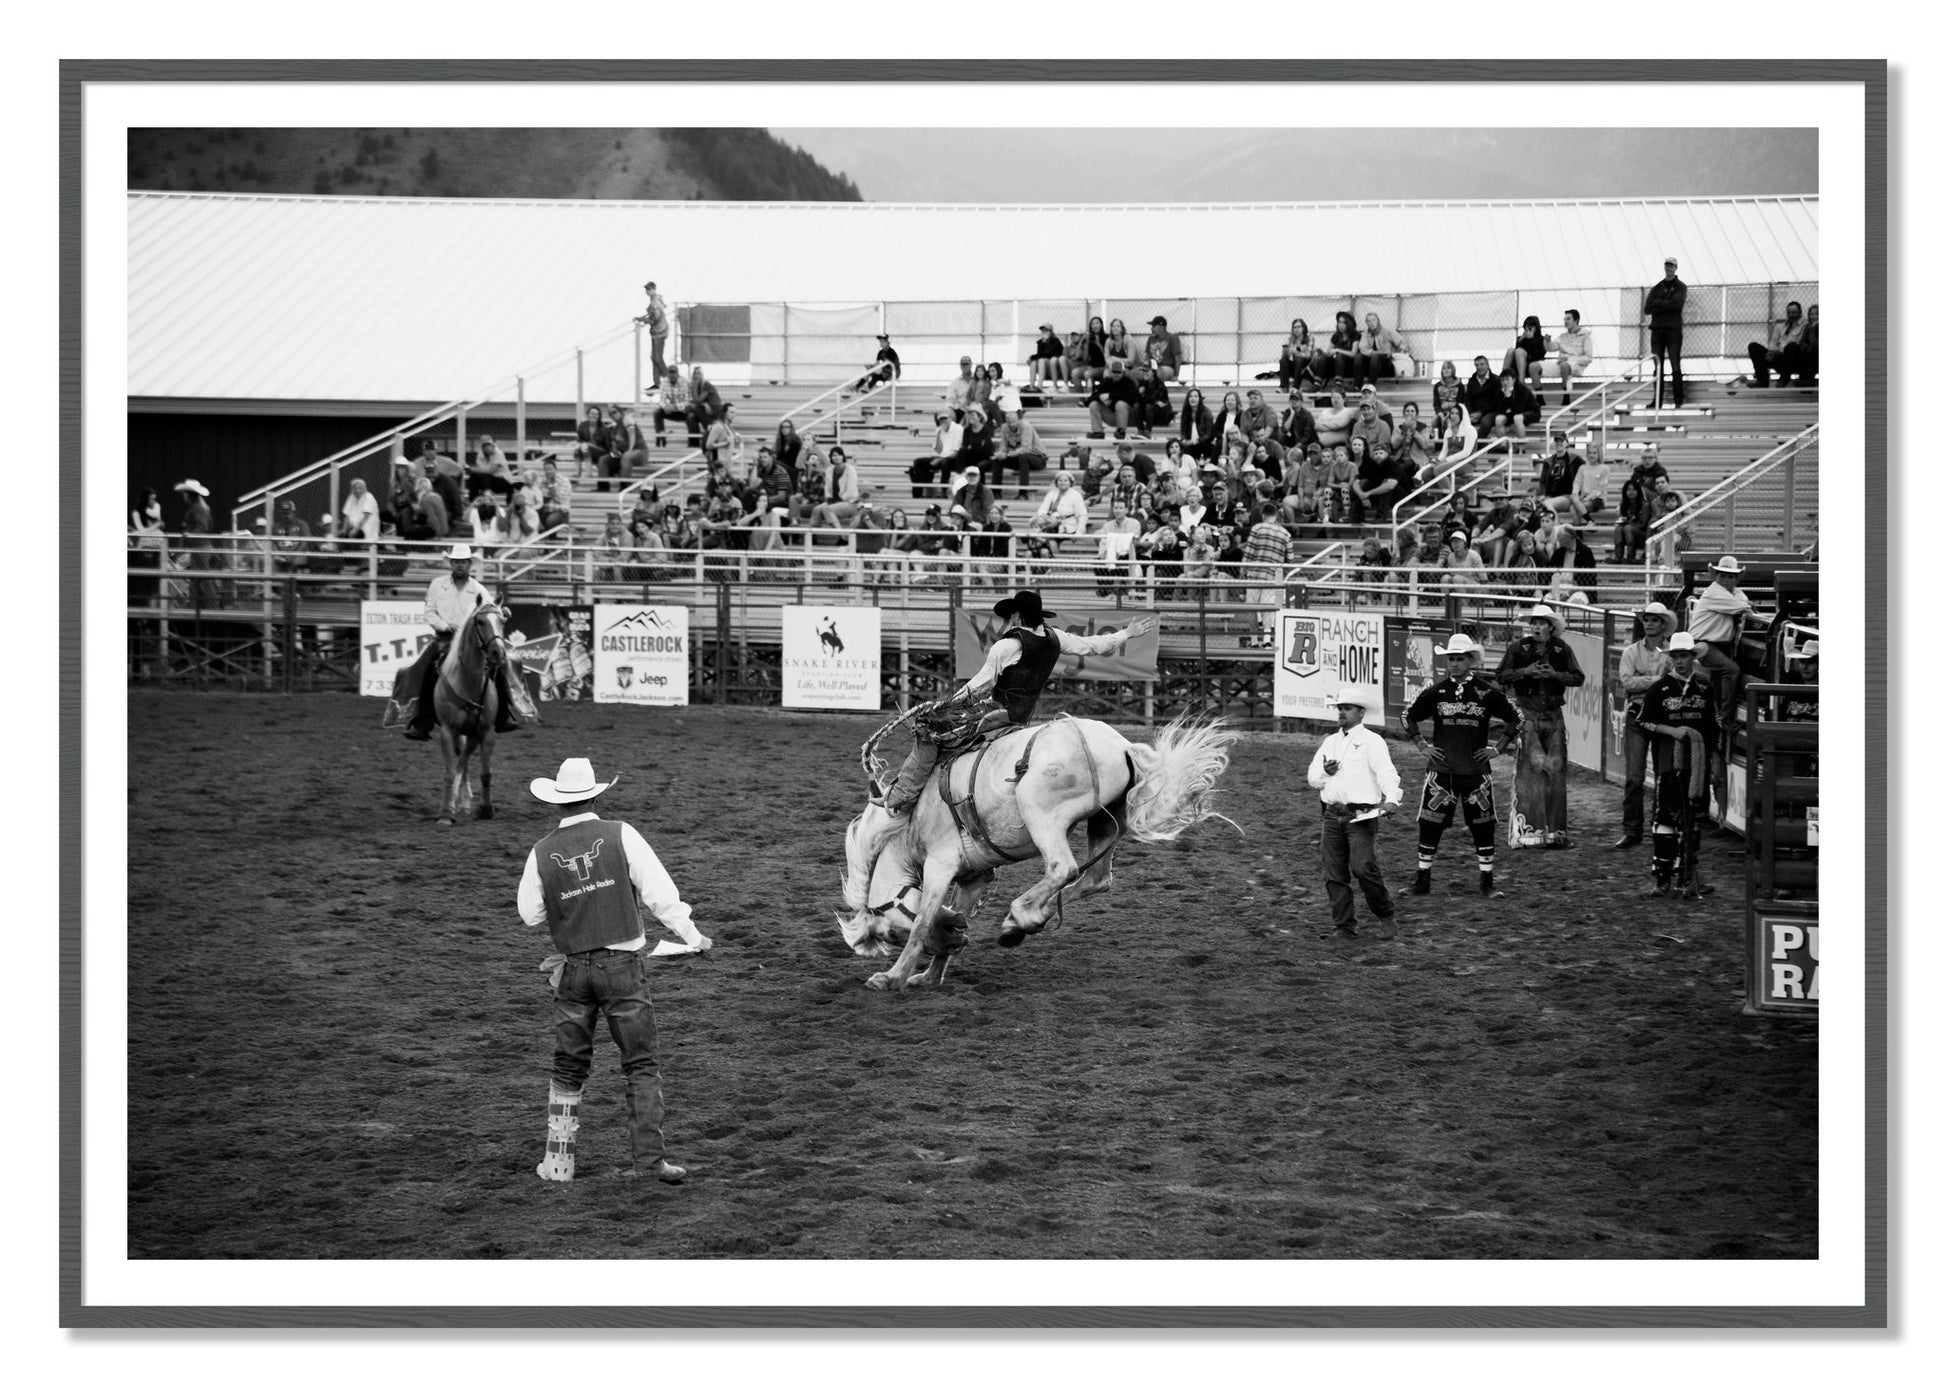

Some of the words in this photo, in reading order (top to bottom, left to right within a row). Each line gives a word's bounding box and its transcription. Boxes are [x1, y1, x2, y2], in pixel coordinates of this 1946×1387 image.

[1321, 618, 1379, 644] RANCH
[601, 635, 682, 653] CASTLEROCK
[1287, 632, 1317, 665] R
[784, 659, 828, 668] SNAKE
[836, 660, 879, 670] RIVER
[1323, 652, 1338, 667] AND
[1339, 644, 1379, 685] HOME
[640, 672, 668, 688] Jeep
[818, 680, 838, 690] Well
[838, 681, 868, 692] Played
[561, 889, 582, 899] Jackson
[582, 883, 596, 893] Hole
[596, 879, 615, 888] Rodeo
